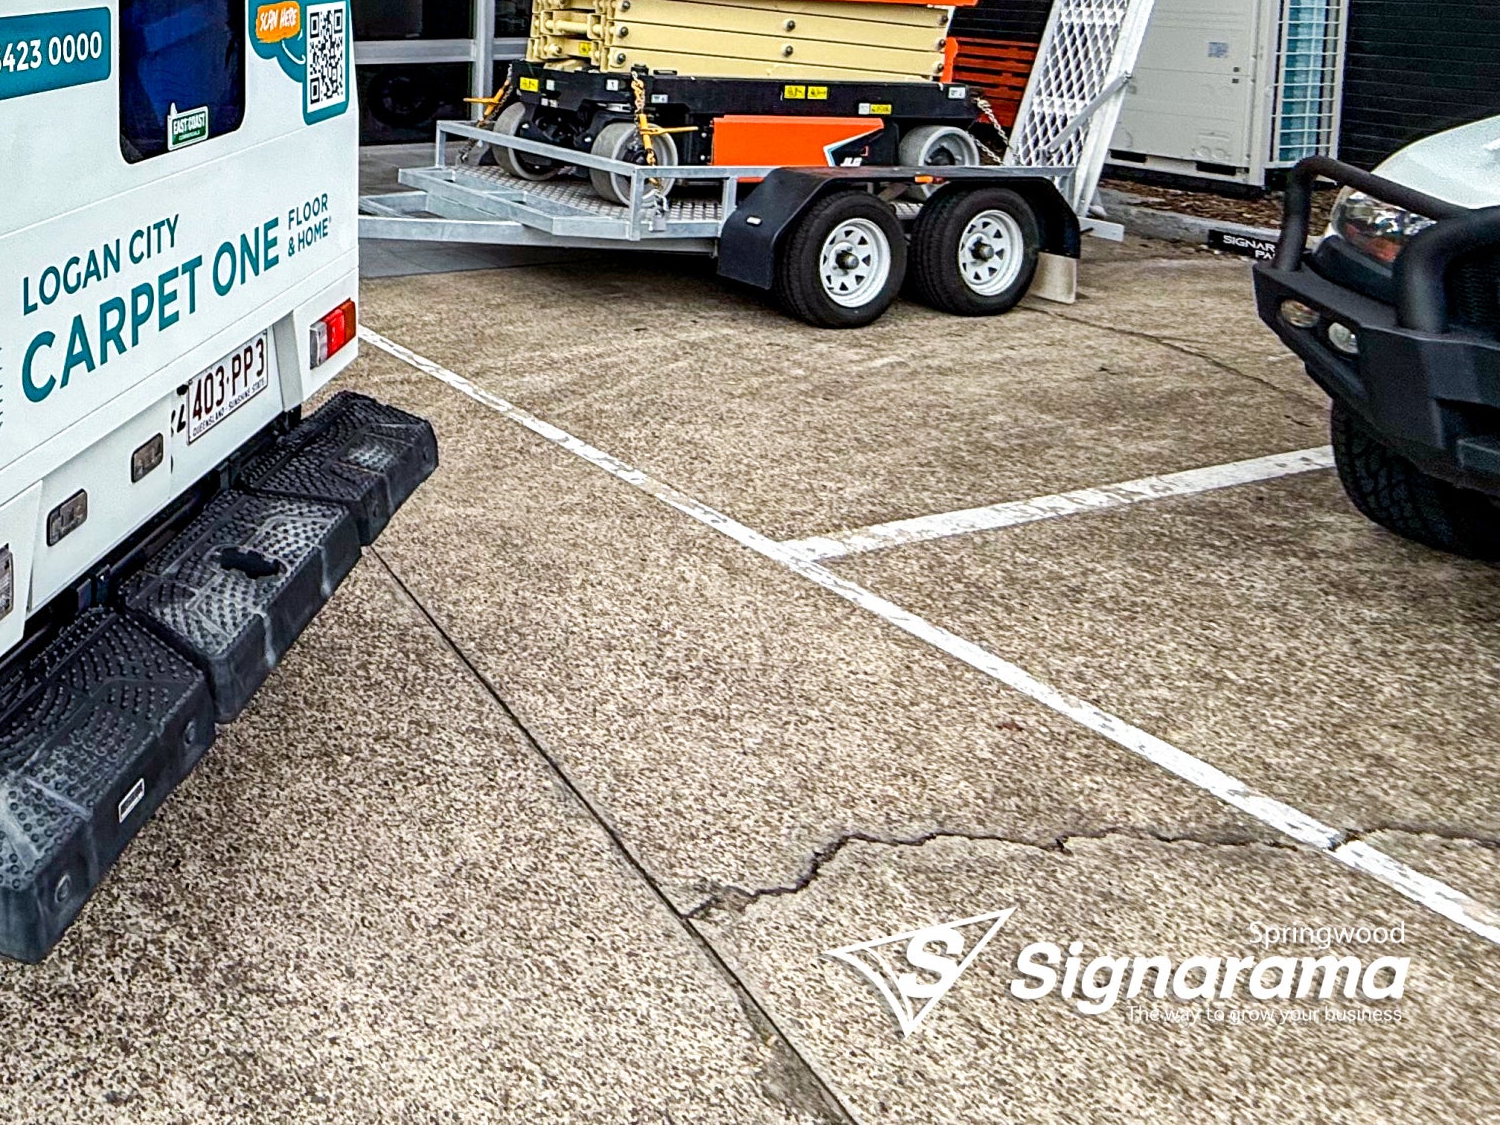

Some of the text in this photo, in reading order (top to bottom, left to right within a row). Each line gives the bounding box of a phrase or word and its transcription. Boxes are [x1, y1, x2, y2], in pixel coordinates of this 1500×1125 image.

[259, 6, 298, 32] SCAN HERE
[48, 31, 103, 67] 0000
[288, 192, 329, 230] FLOOR
[287, 236, 296, 258] &
[1222, 234, 1276, 253] SIGNAR
[23, 213, 180, 316] LOGAN CITY
[21, 216, 280, 403] CARPET ONE
